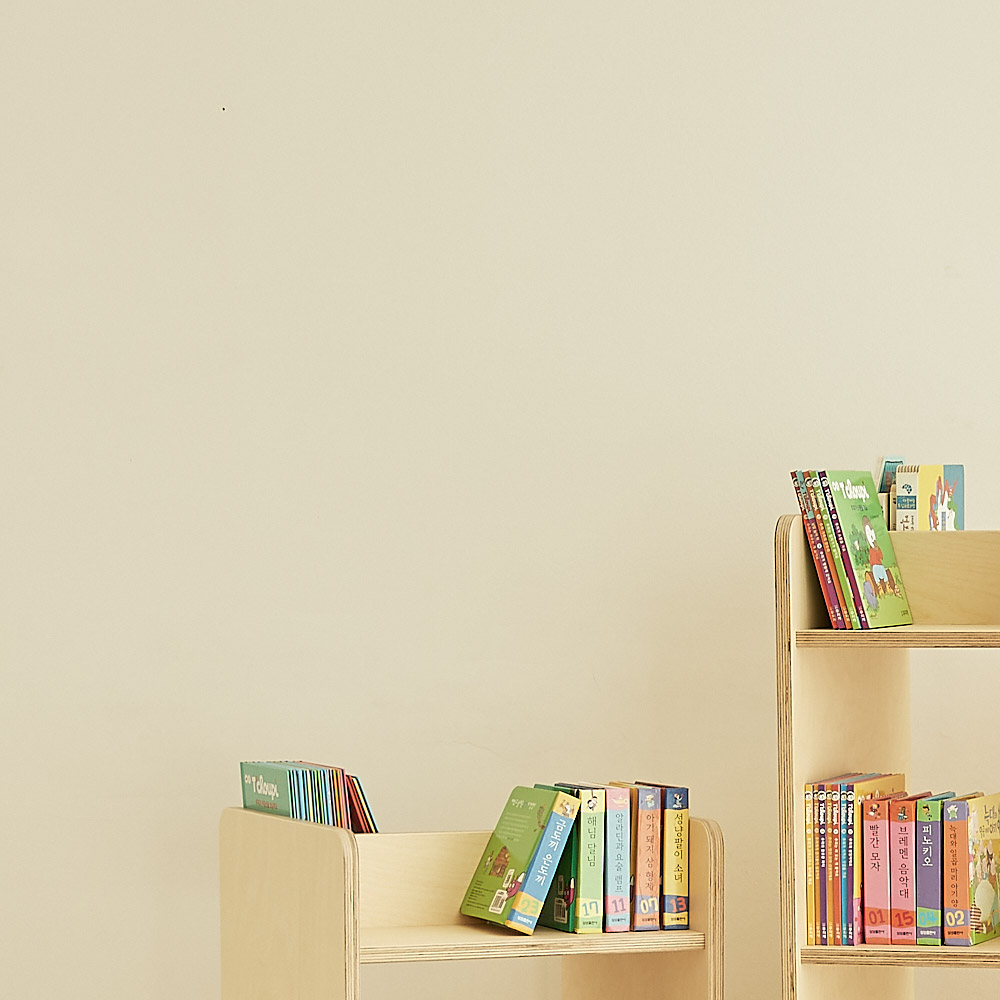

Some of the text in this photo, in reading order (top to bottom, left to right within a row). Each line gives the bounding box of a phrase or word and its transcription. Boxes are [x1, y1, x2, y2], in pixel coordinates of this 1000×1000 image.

[535, 819, 566, 886] 금도끼 은도끼
[587, 816, 597, 867] 해님 달님
[615, 813, 624, 893] 알라딘과 요술 램프
[645, 814, 655, 891] 아기 돼지 삼 형제
[674, 813, 684, 883] 성냥팔이 소녀
[869, 824, 881, 872] 빨간 모자
[922, 824, 933, 867] 피노키오
[898, 826, 909, 899] 브레멘 음악대
[949, 824, 959, 908] 늑대와 일곱 마리 아기 양
[521, 898, 539, 914] 23
[582, 901, 599, 917] 17
[612, 898, 627, 913] 11
[640, 897, 659, 914] 07
[670, 897, 687, 913] 13
[869, 909, 886, 925] 01
[895, 911, 914, 927] 15
[918, 911, 938, 926] 04
[946, 910, 965, 927] 02
